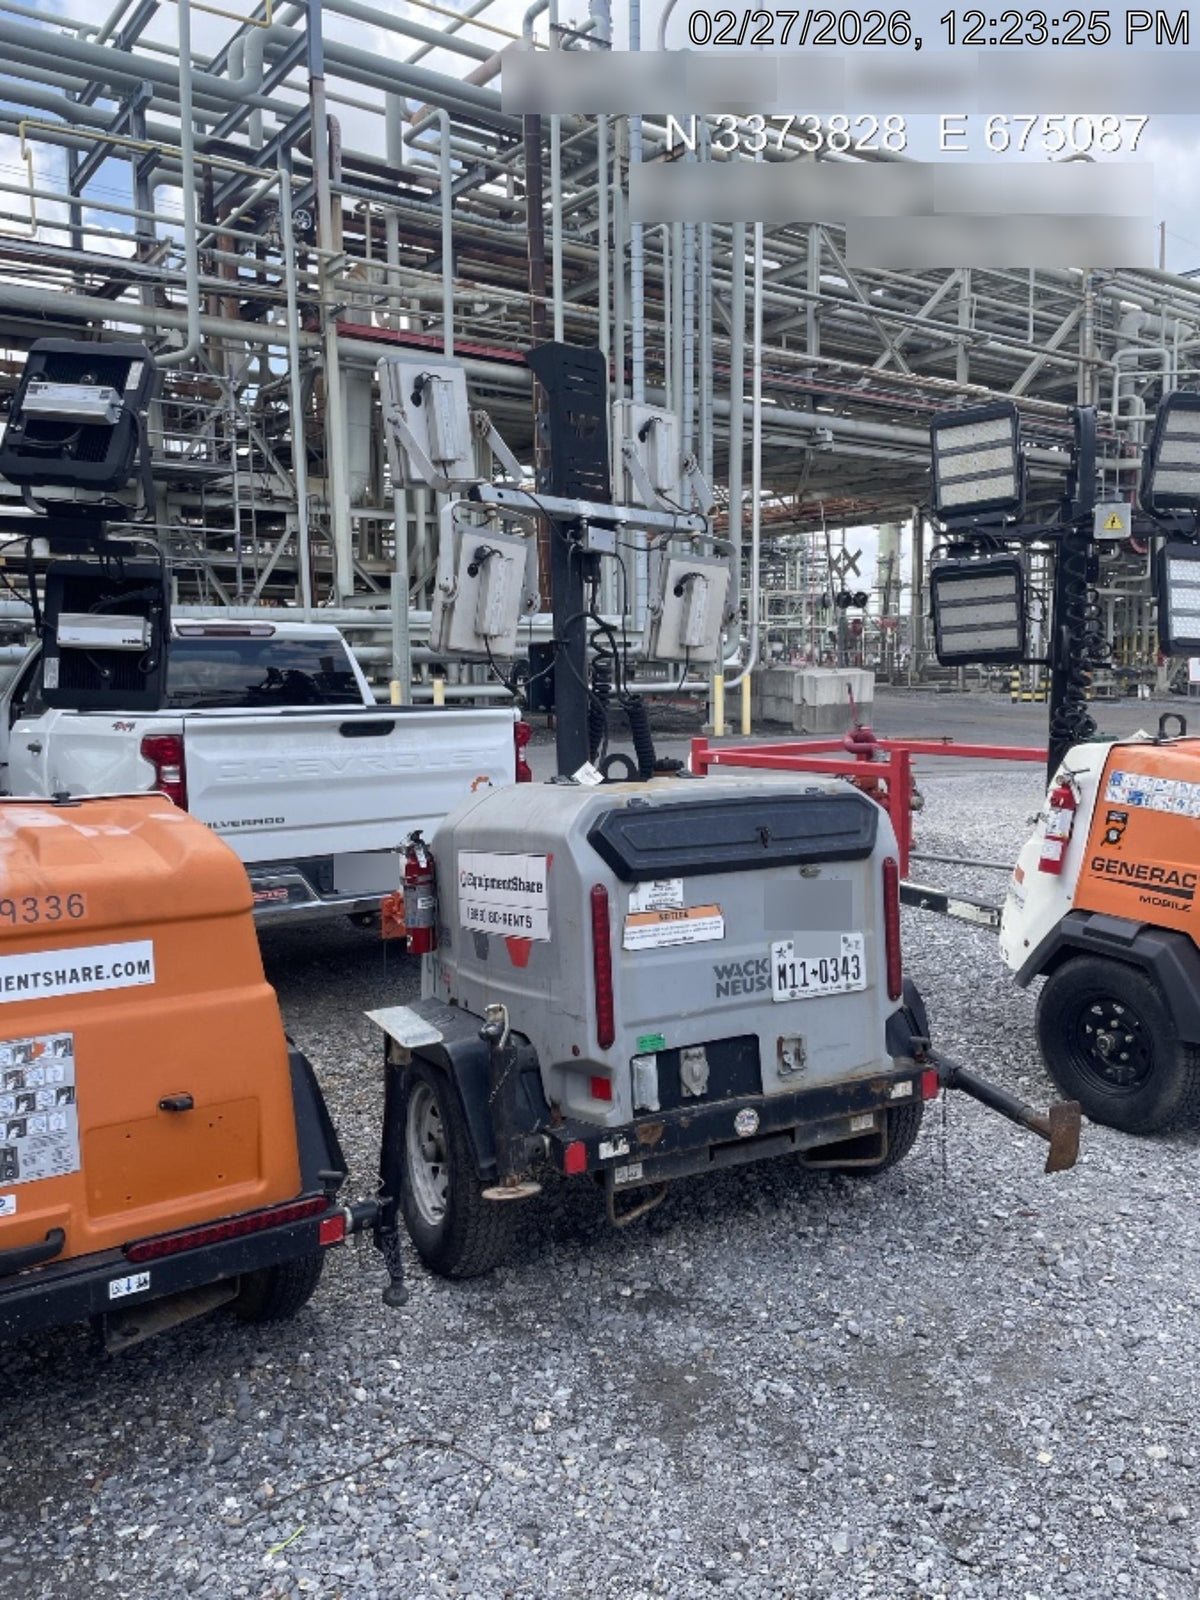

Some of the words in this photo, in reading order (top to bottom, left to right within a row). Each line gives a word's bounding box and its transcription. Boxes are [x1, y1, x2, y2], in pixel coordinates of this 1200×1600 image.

[203, 816, 286, 830] ILVERADO
[1091, 856, 1197, 888] GENERAC
[0, 893, 84, 923] 9336
[1139, 895, 1192, 912] MOBILE
[0, 959, 150, 992] ENTSHARE.COM
[713, 958, 769, 980] WACK
